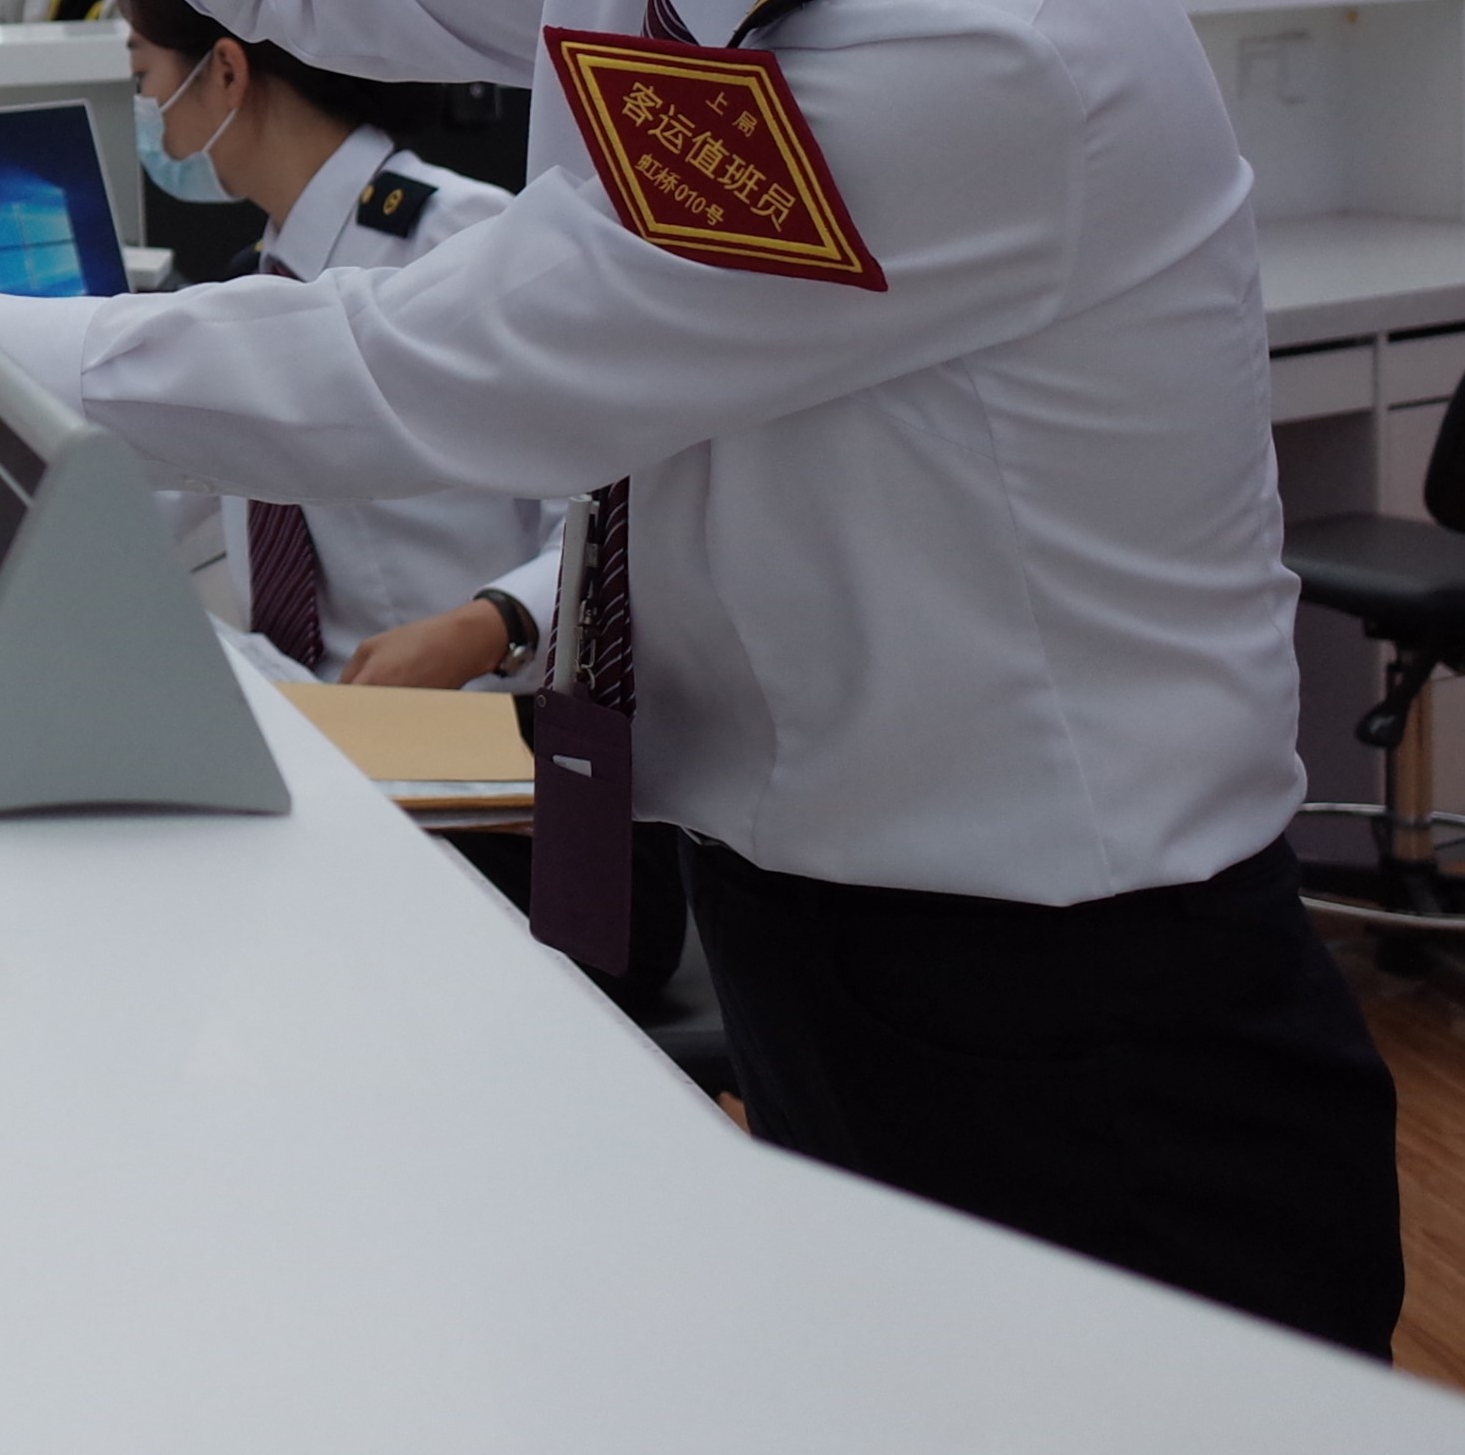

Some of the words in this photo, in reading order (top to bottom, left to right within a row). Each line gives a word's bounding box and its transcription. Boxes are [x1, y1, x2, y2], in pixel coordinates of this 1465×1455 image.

[621, 82, 797, 232] 客运值班员
[634, 153, 725, 227] 虹桥010号
